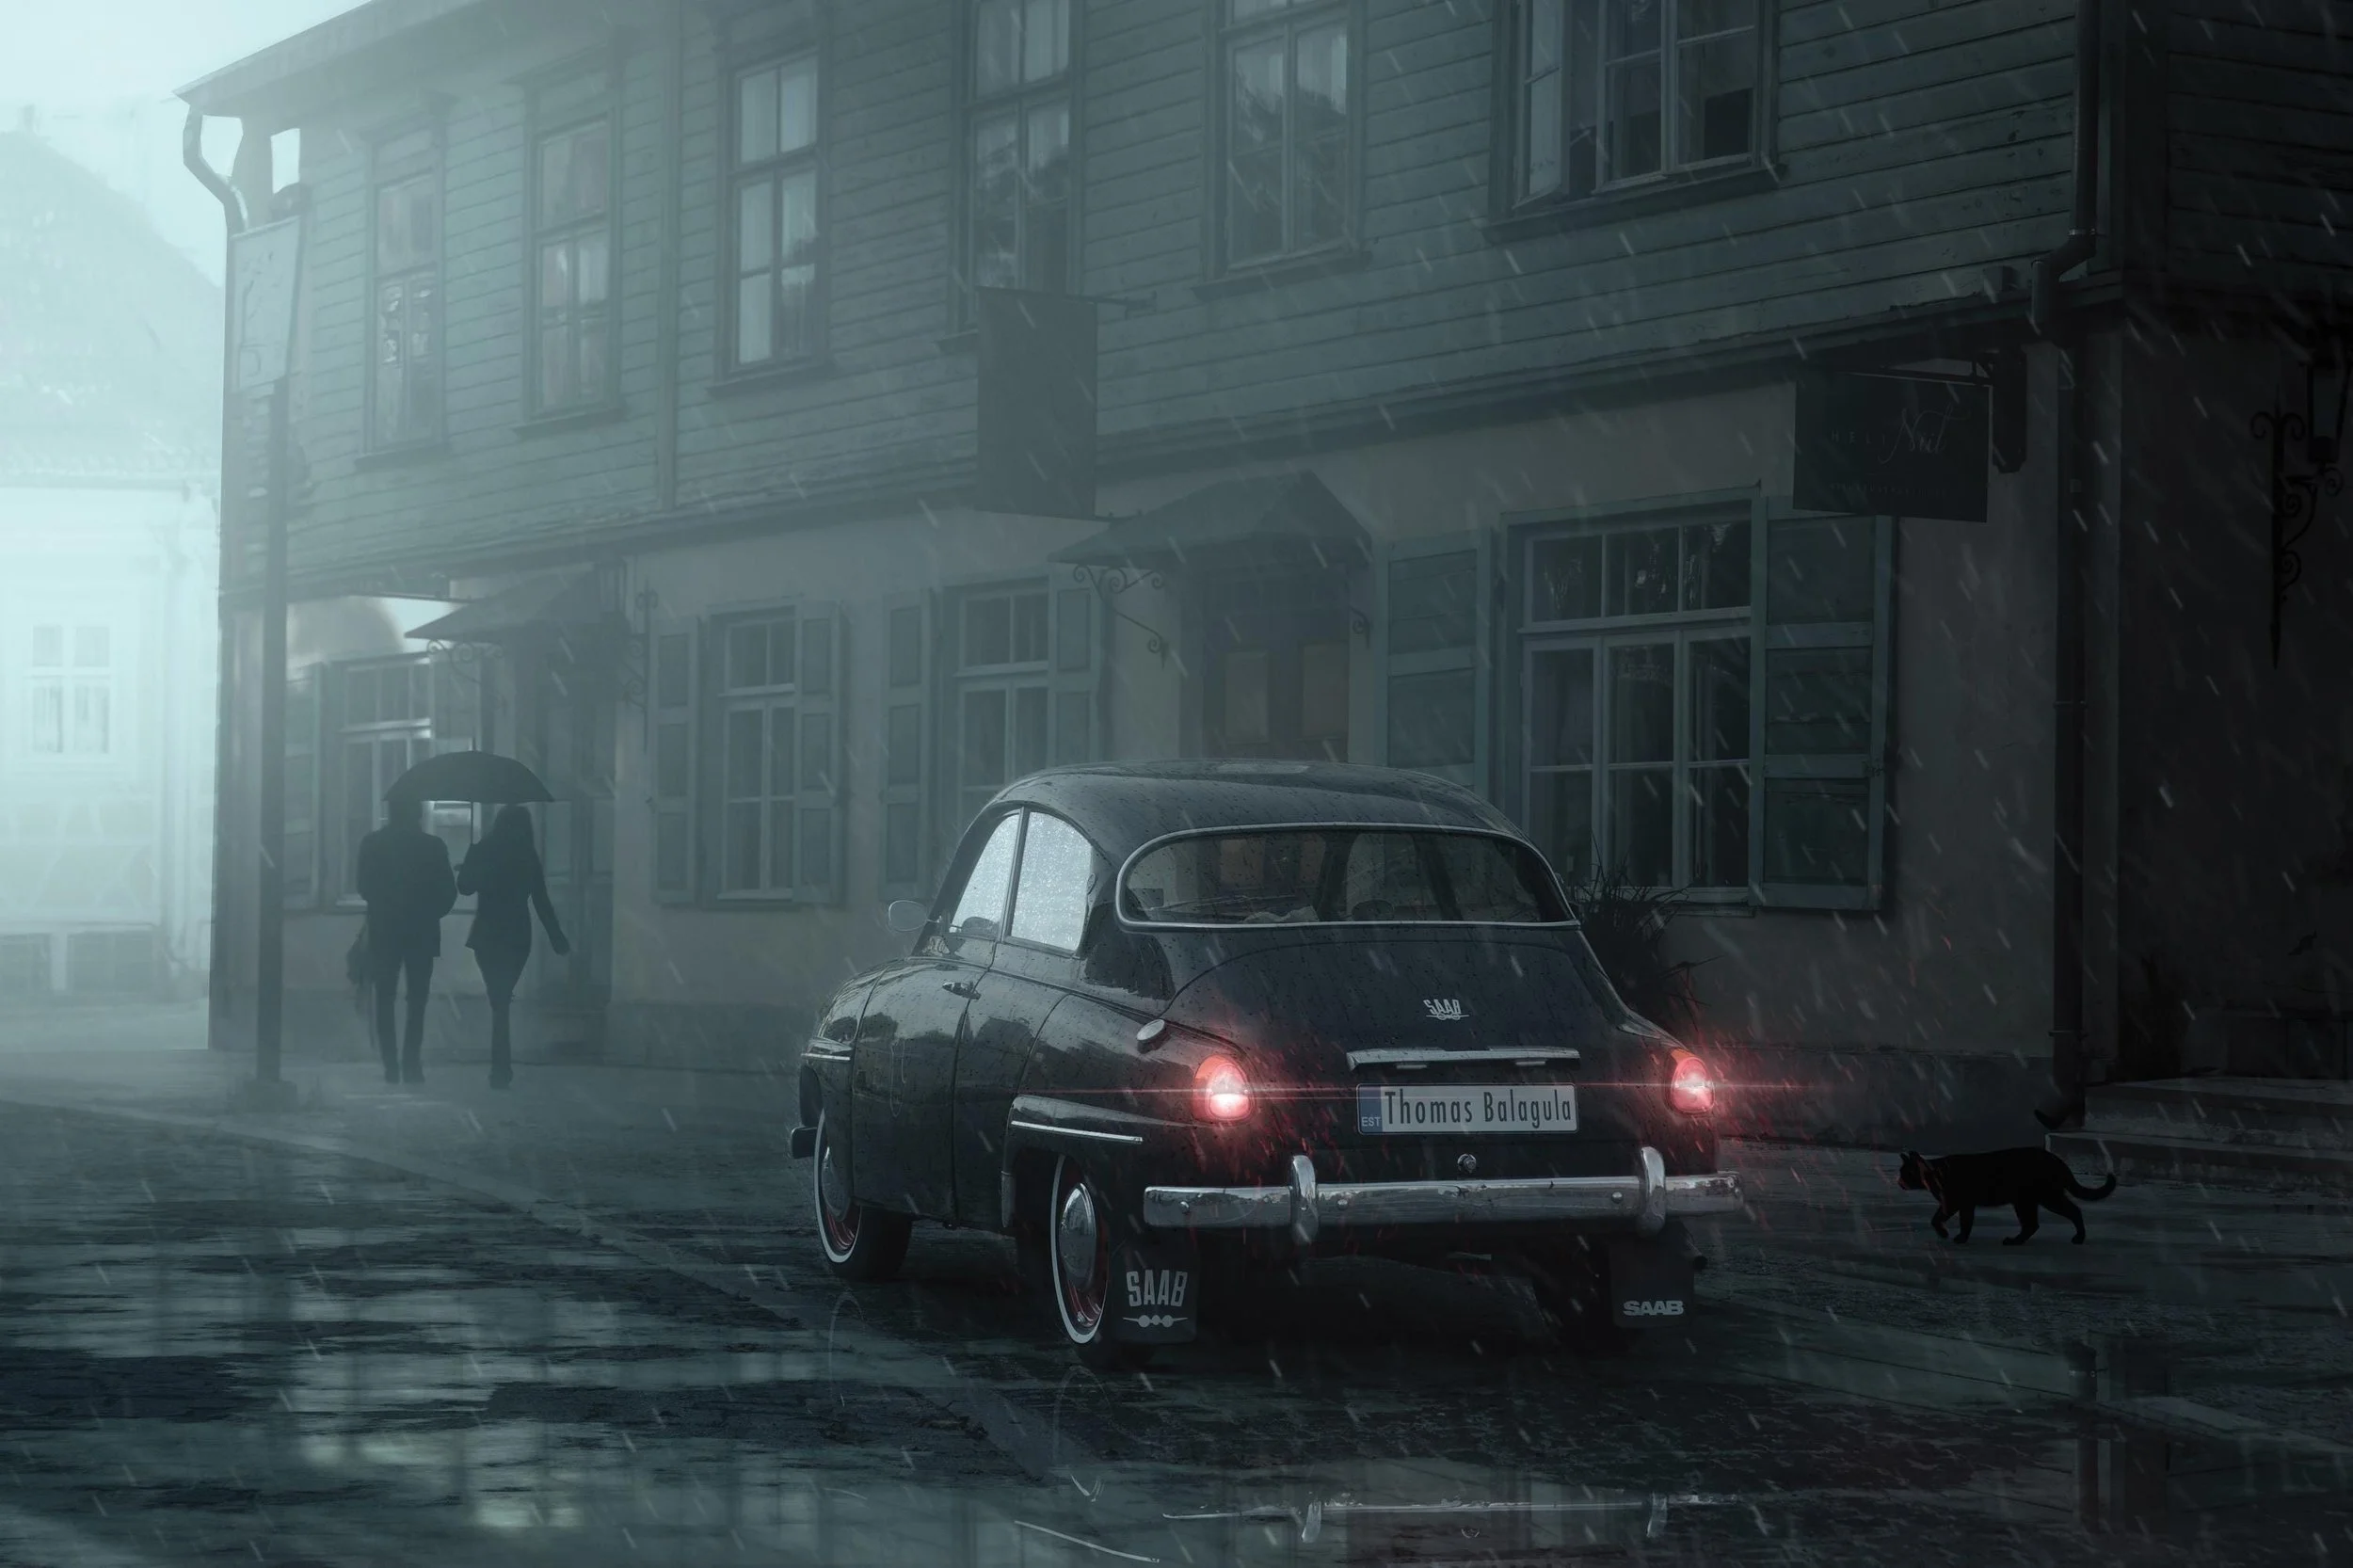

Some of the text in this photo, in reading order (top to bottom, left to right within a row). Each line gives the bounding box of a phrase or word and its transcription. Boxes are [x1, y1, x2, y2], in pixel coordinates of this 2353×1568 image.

[1422, 999, 1462, 1016] SAAB
[1385, 1088, 1572, 1128] Thomas Balagula
[1361, 1116, 1382, 1128] EST
[1126, 1270, 1189, 1307] SAAB
[1623, 1300, 1684, 1317] SAAB
